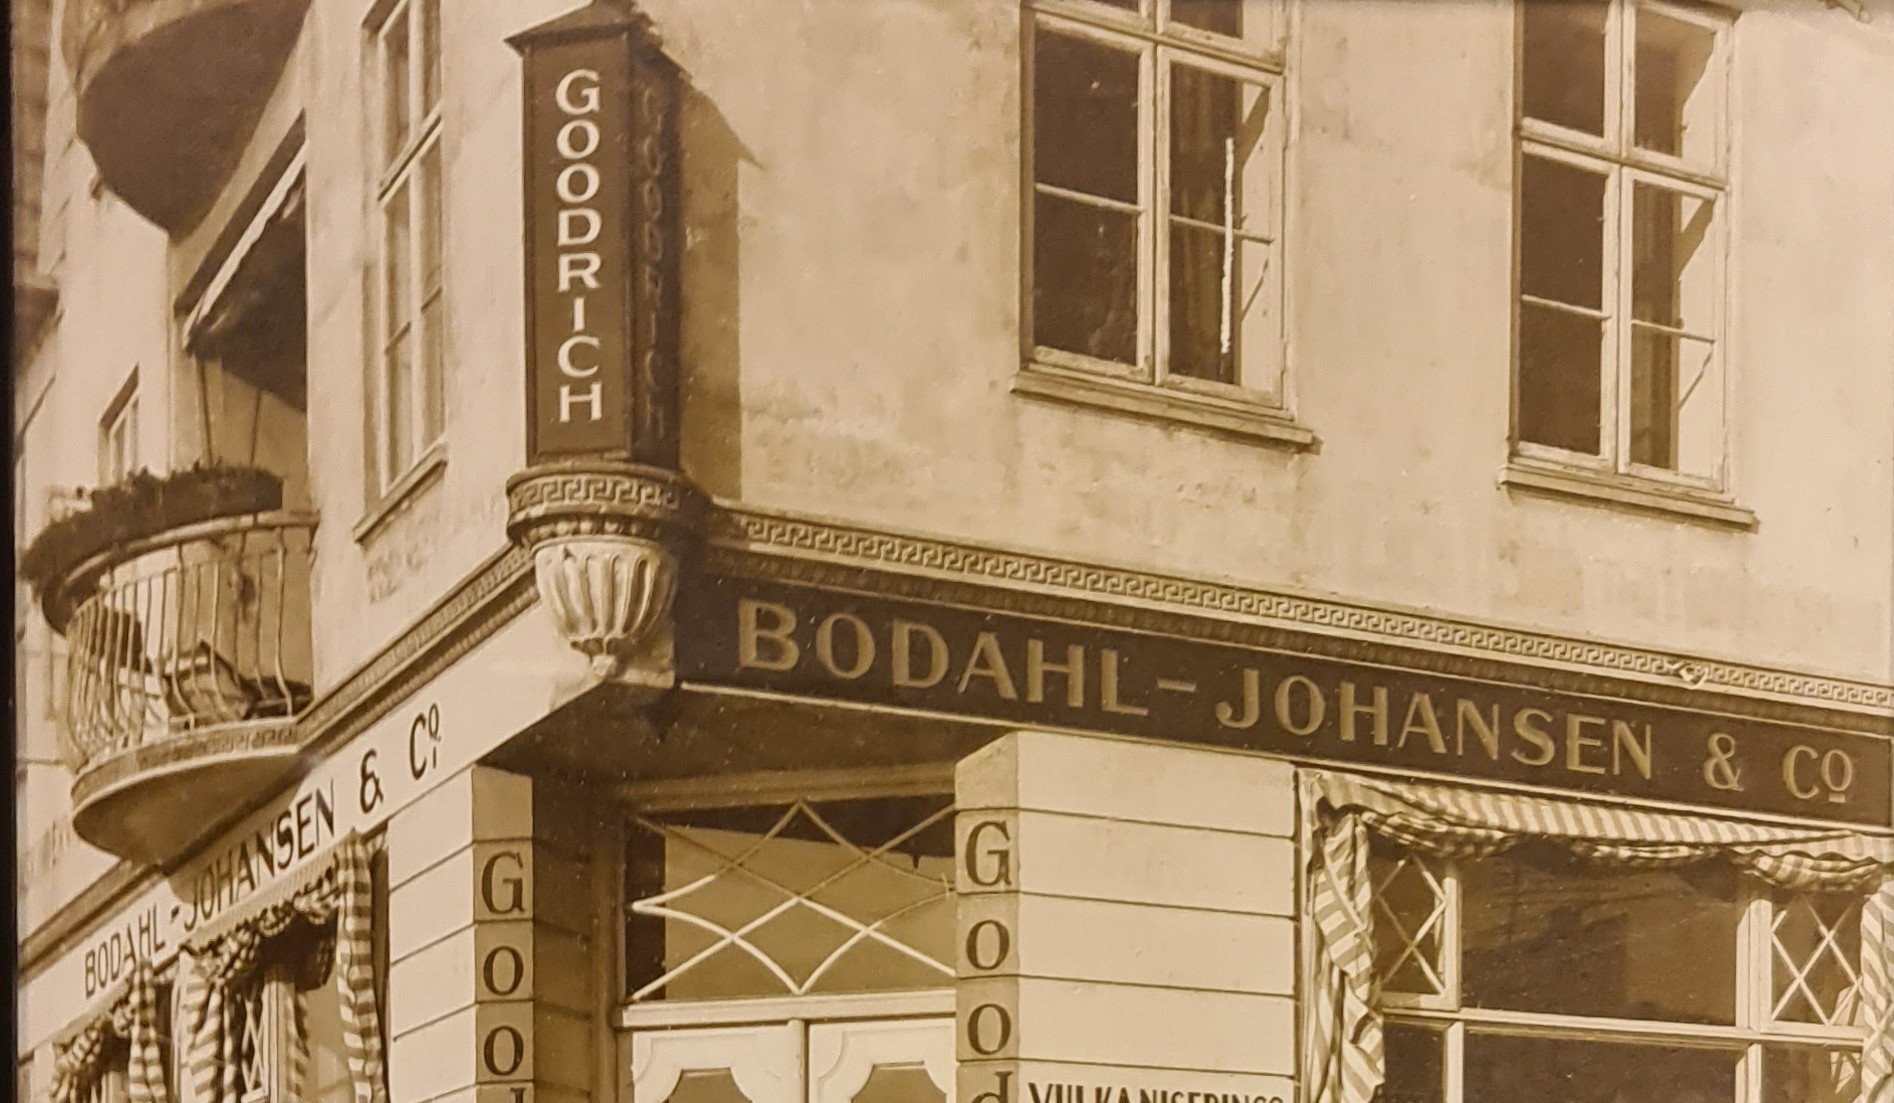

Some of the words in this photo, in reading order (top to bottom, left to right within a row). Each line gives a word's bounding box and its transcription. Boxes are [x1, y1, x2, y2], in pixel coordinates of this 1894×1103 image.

[555, 68, 603, 423] GOODRICH
[360, 748, 385, 815] &
[1703, 732, 1745, 793] &
